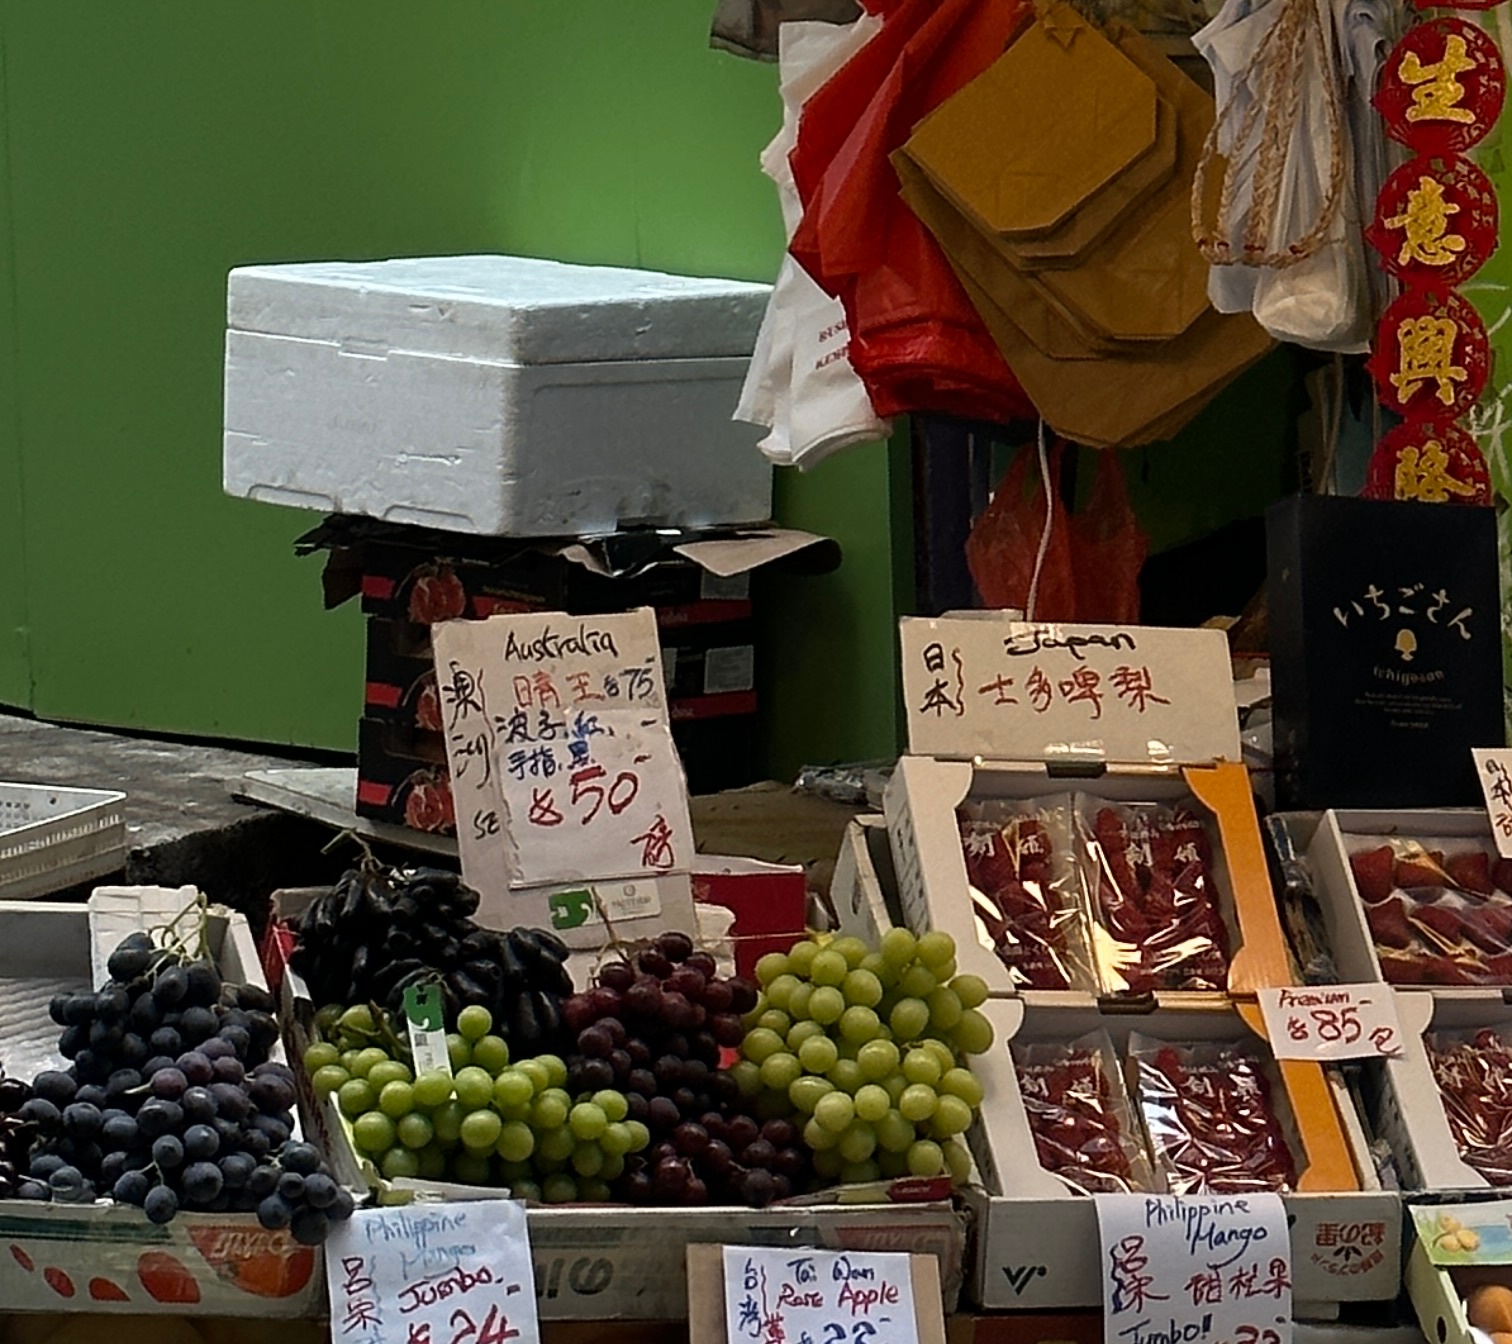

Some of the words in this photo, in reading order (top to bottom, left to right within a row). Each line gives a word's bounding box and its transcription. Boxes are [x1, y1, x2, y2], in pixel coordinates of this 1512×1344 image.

[1331, 580, 1476, 642] いちごさん
[504, 623, 620, 662] Australia
[1003, 629, 1136, 660] Japan
[920, 642, 957, 717] 日本
[364, 1212, 467, 1249] Philippine
[1145, 1197, 1251, 1242] Philippine
[837, 1280, 899, 1317] Apple
